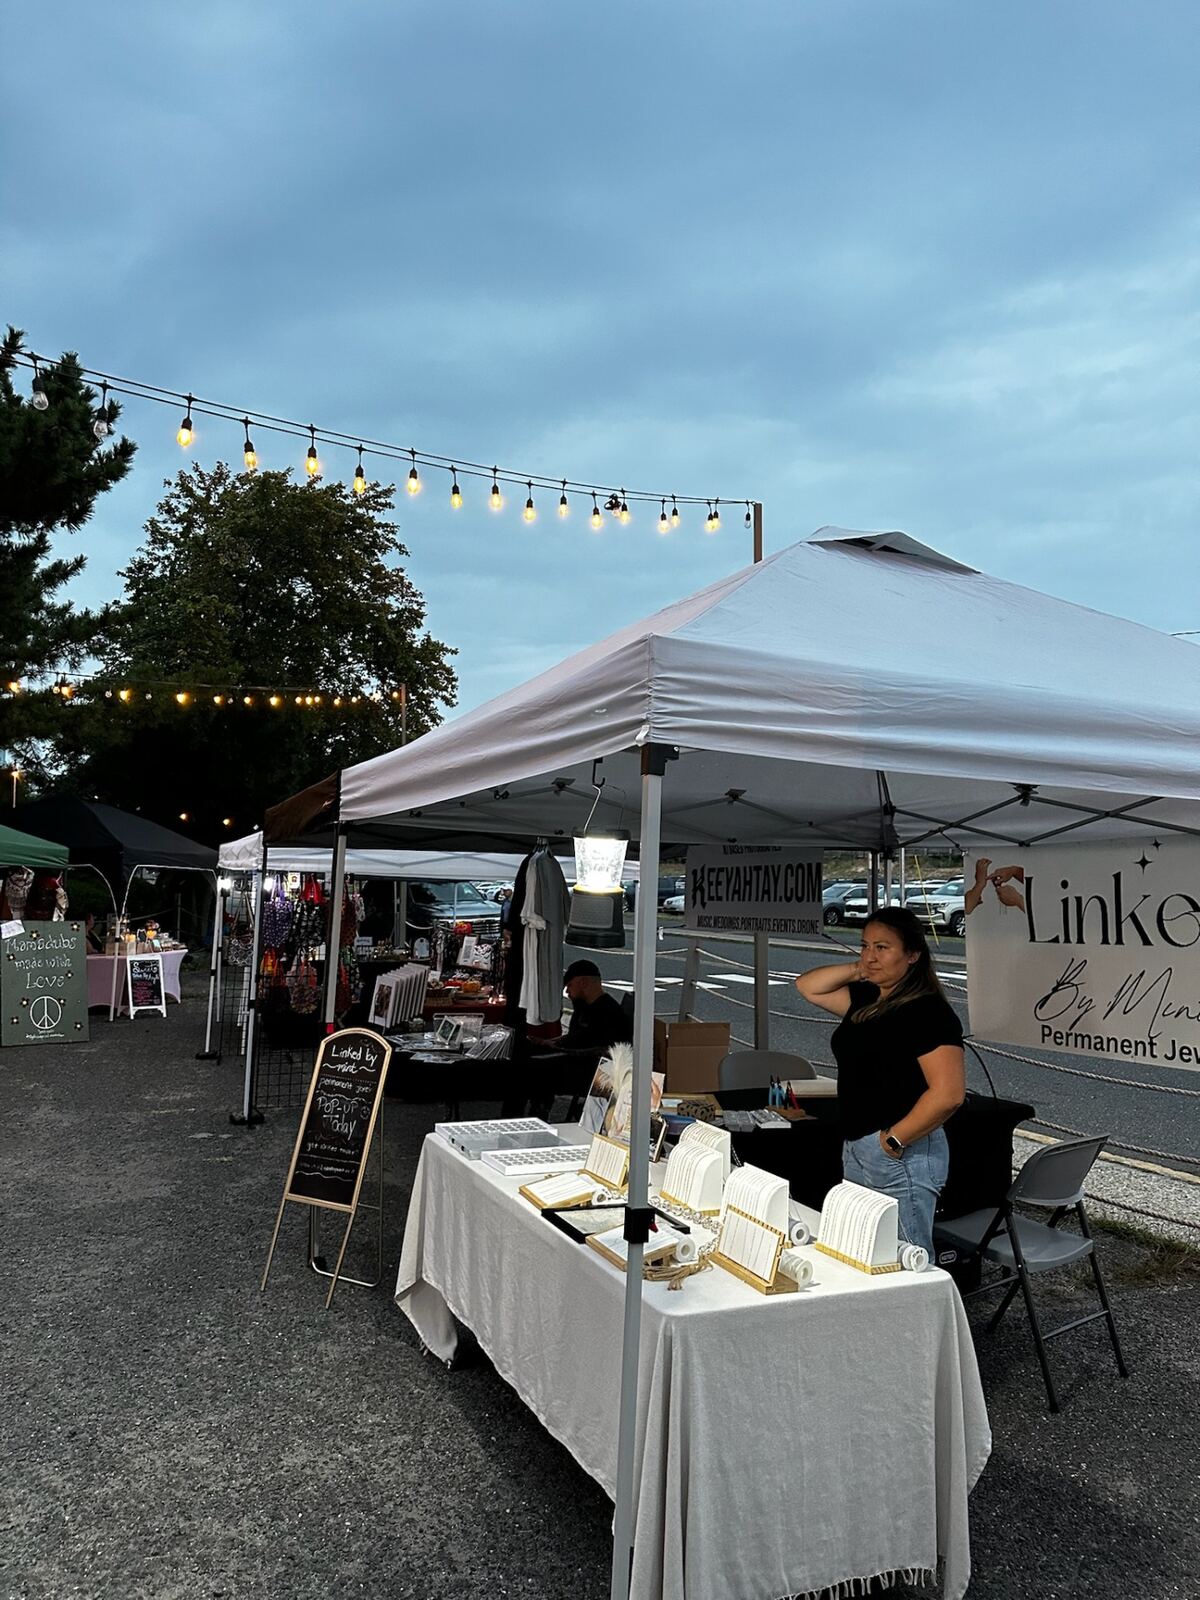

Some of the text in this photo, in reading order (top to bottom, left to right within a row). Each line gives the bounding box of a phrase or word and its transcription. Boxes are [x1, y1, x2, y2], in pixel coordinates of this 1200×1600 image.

[691, 863, 822, 910] KEEYAHTAY.COM
[1025, 871, 1200, 948] Linke
[14, 954, 73, 971] made with
[26, 972, 65, 989] Love
[1034, 958, 1200, 1039] By Min
[1041, 1024, 1157, 1059] Permanent
[337, 1061, 359, 1074] mint
[365, 1048, 378, 1067] by
[316, 1096, 359, 1114] POP-UP
[322, 1113, 357, 1141] Today
